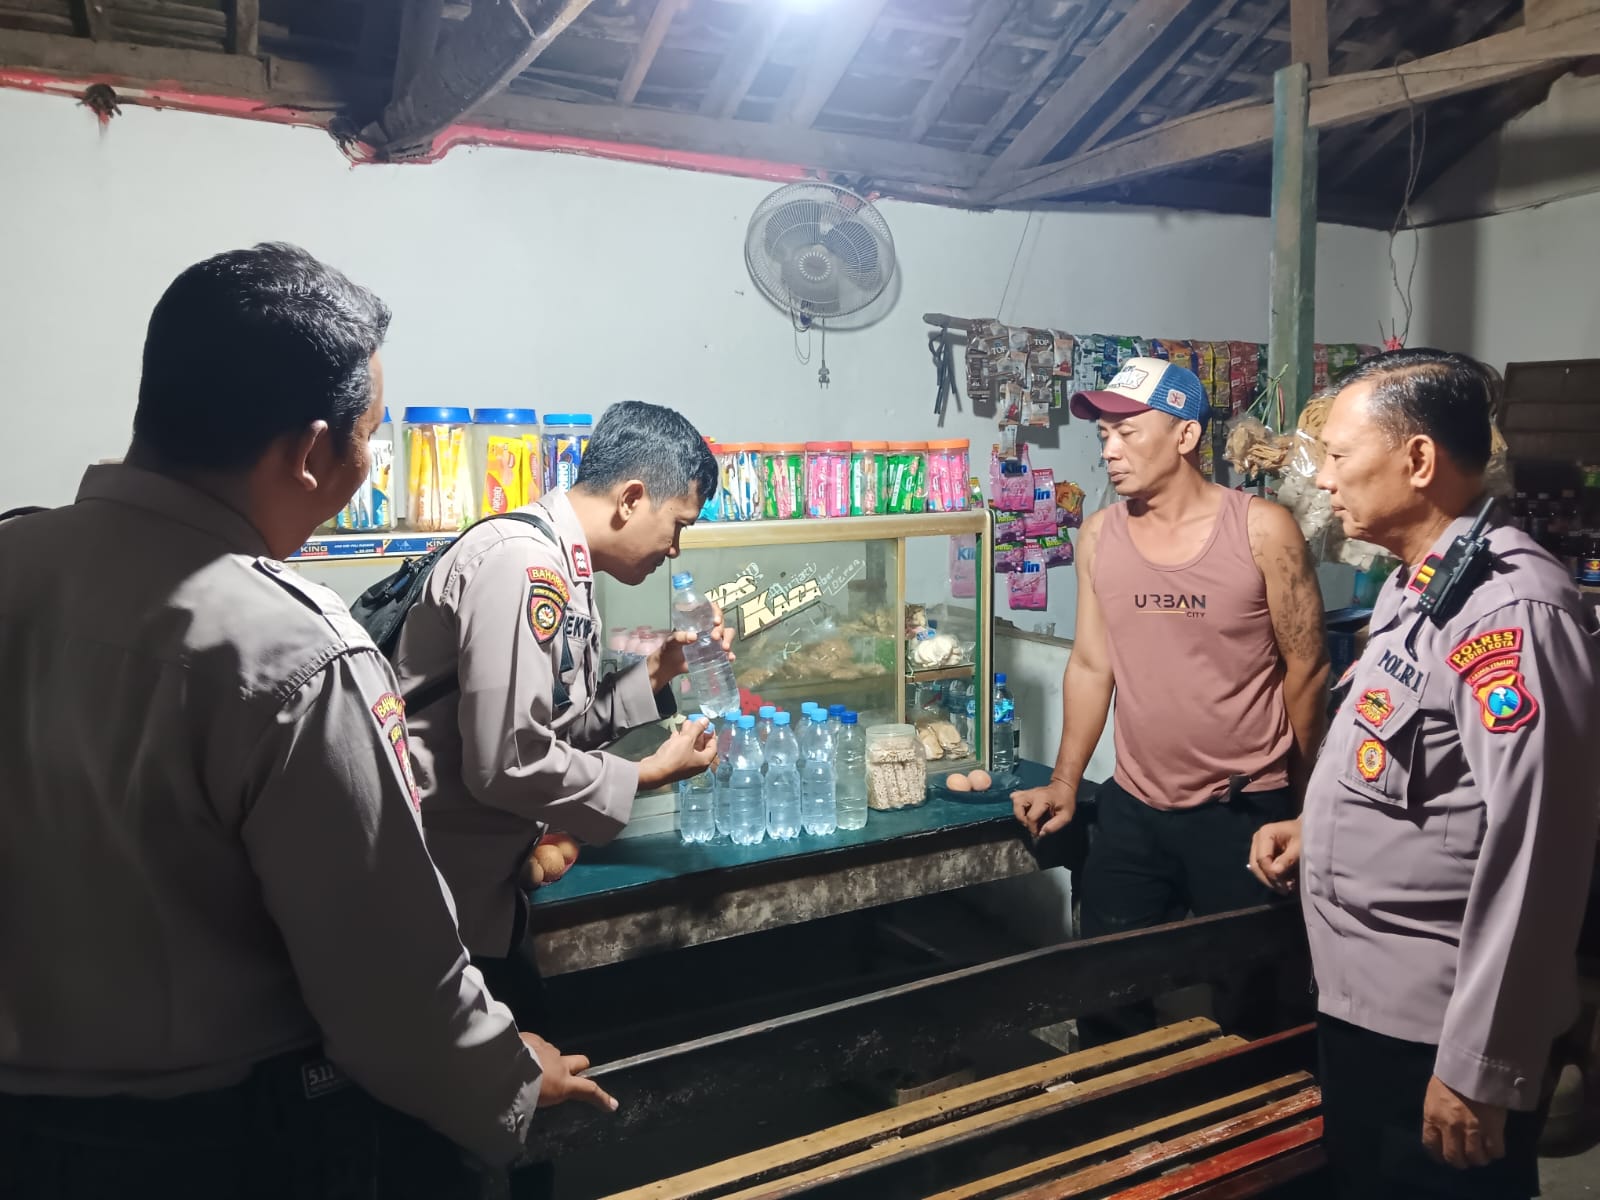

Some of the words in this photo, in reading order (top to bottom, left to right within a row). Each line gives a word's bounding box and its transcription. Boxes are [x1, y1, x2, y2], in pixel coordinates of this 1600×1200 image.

[300, 545, 328, 553] KING
[739, 578, 824, 638] KACA
[1134, 594, 1206, 609] URBAN
[1452, 631, 1514, 666] POLRES
[1488, 640, 1514, 650] KOTA
[1377, 650, 1424, 693] POLRI
